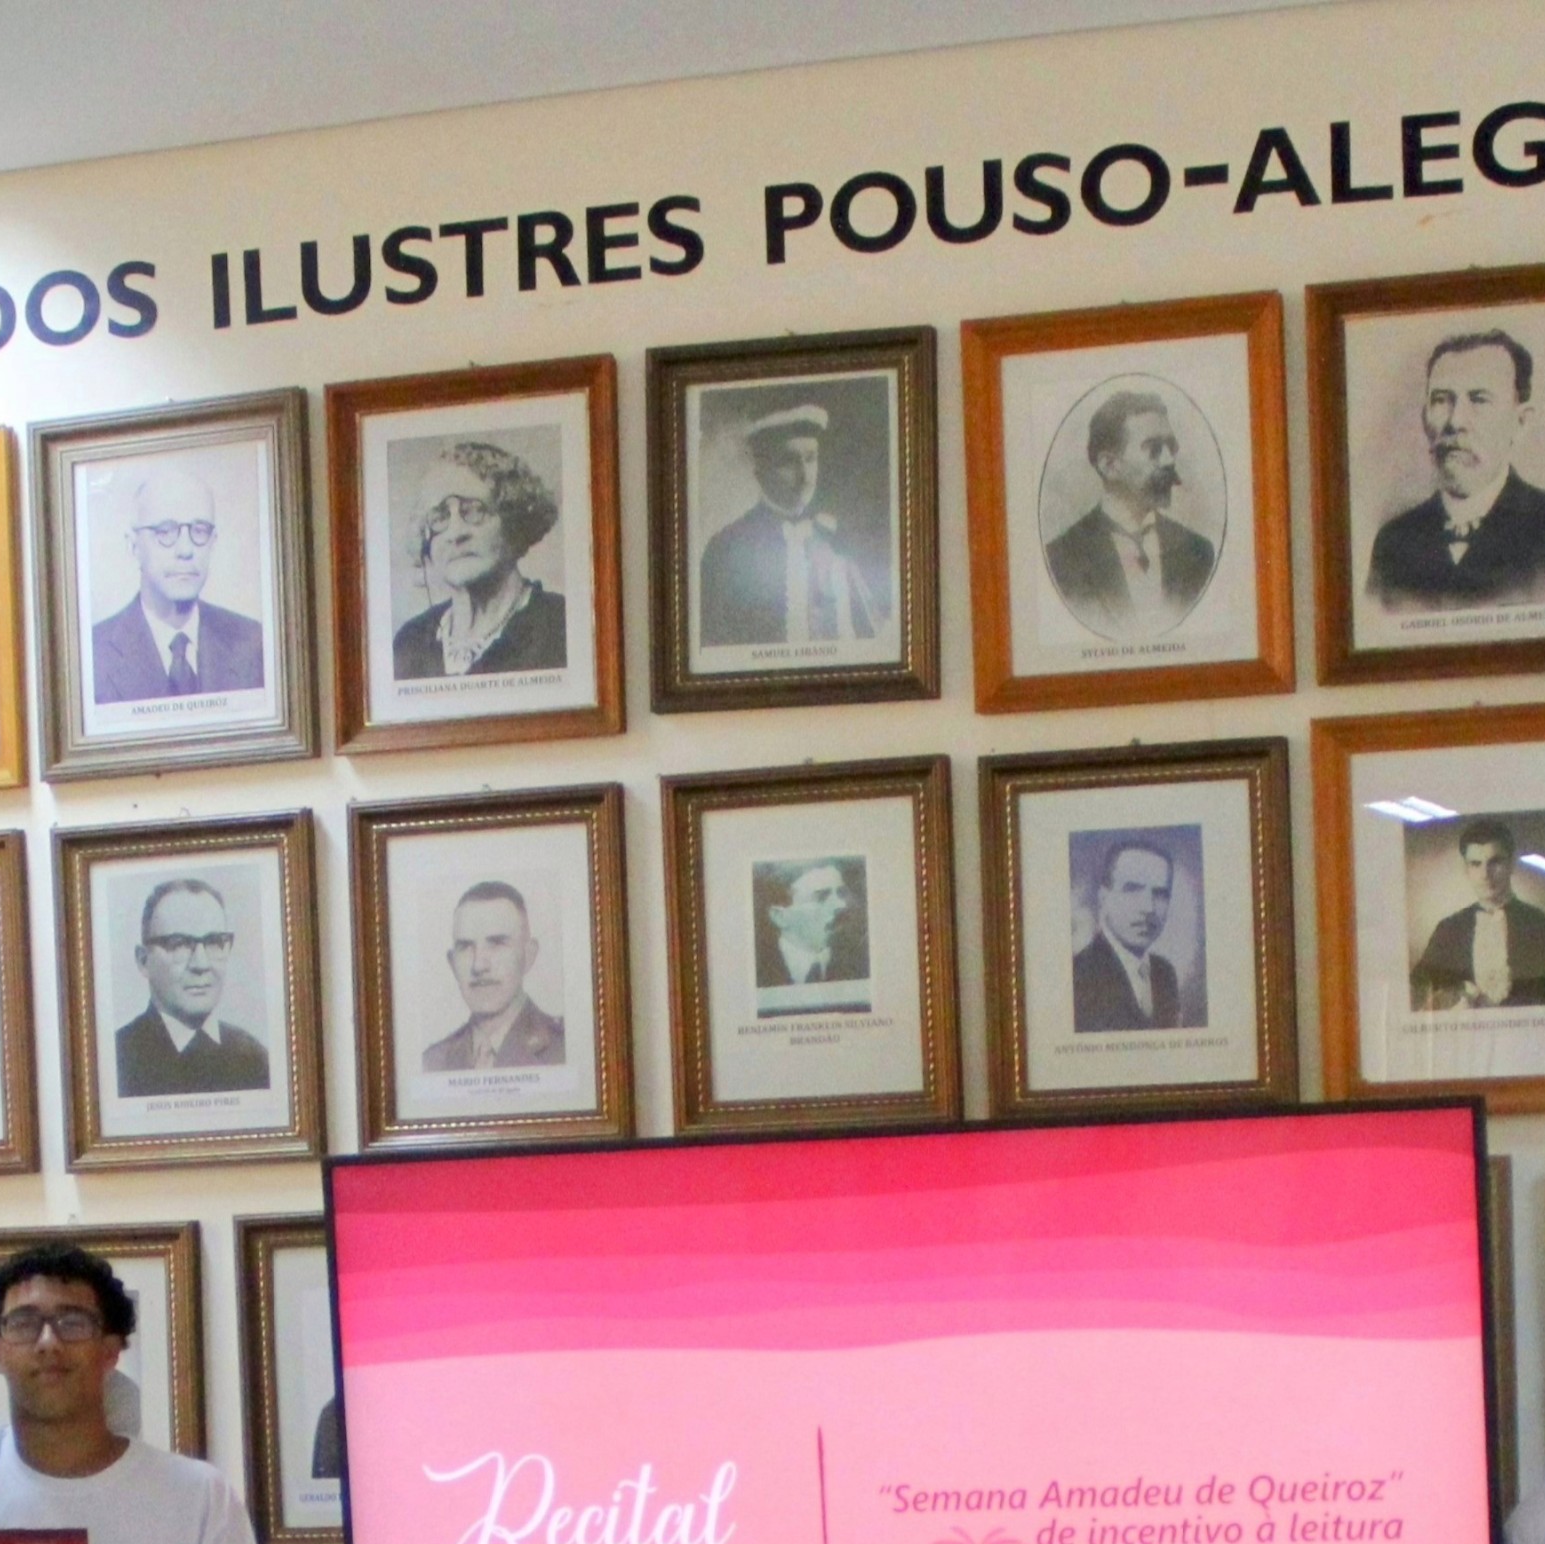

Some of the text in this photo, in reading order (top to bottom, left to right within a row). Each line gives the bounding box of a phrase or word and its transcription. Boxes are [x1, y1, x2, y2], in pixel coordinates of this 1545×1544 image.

[212, 195, 705, 328] ILUSTRES
[1400, 618, 1447, 630] GABRIEL
[1496, 612, 1510, 624] DE
[752, 648, 791, 660] SAMUEL
[1121, 645, 1135, 656] DE
[1138, 642, 1186, 655] ALMEIDA
[398, 673, 564, 697] PRISCILIANA DUARTE DE ALMEIDA
[132, 697, 229, 715] AMADEU DE QUEIROZ
[1169, 1040, 1183, 1049] DE
[482, 1073, 541, 1086] FERNANDES
[879, 1483, 1027, 1514] “Semana
[1038, 1478, 1184, 1510] Amadeu
[1195, 1476, 1236, 1507] de
[1255, 1512, 1278, 1544] à
[1289, 1511, 1405, 1543] leitura
